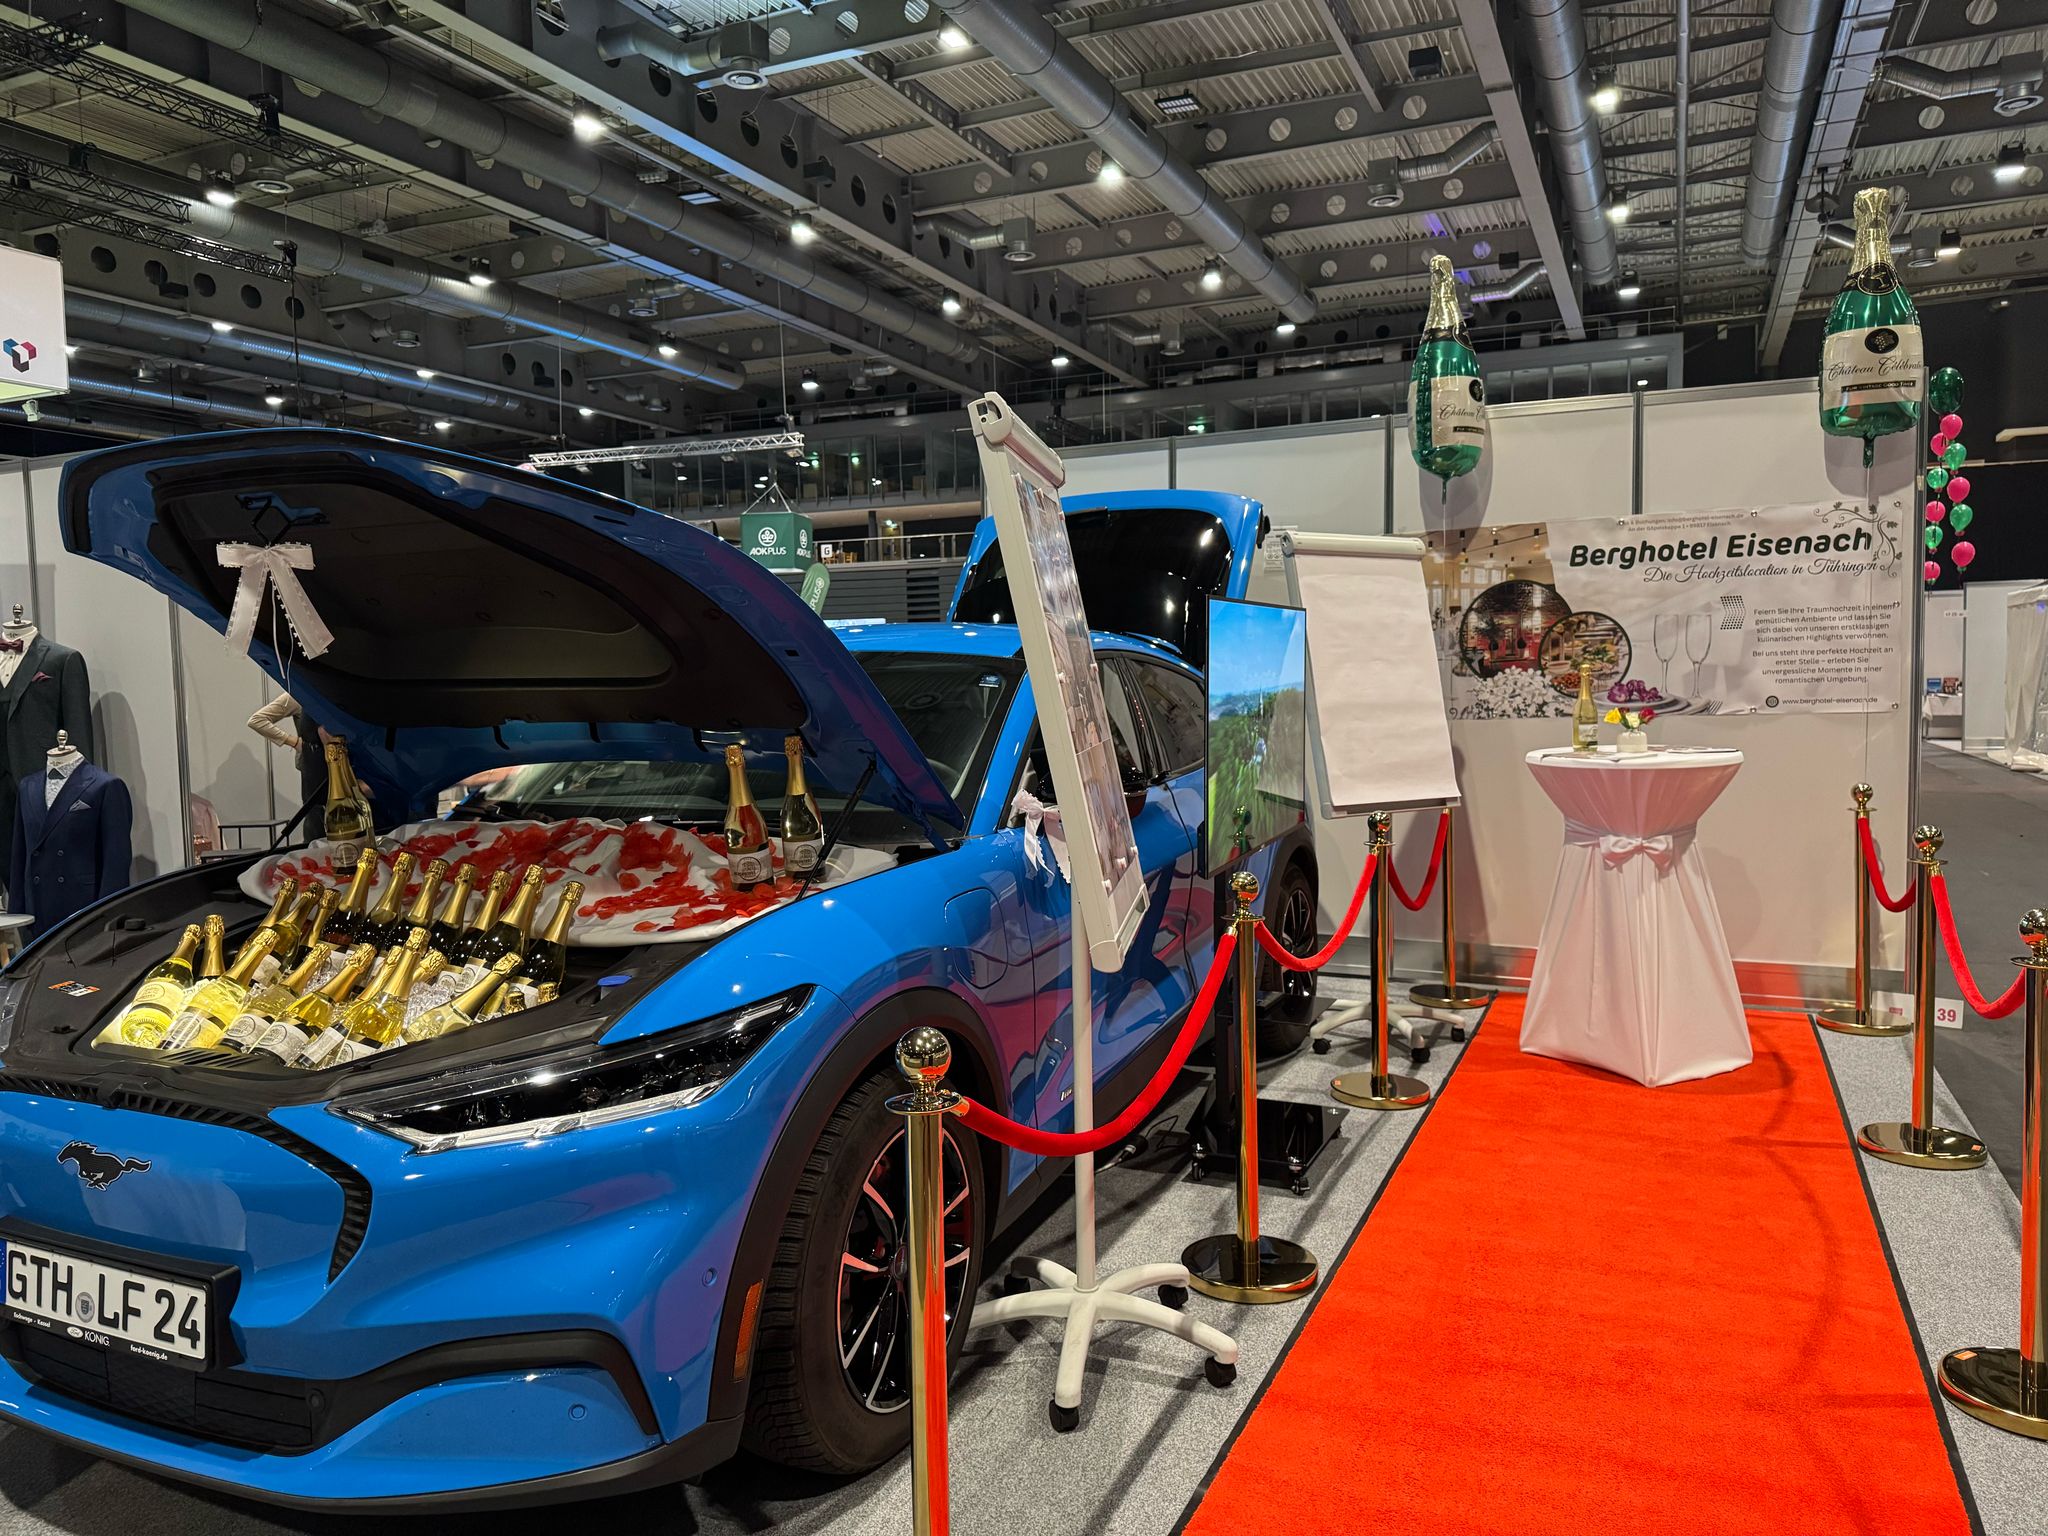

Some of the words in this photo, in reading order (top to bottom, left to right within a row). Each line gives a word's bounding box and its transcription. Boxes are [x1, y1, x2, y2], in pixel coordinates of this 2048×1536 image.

[824, 546, 830, 555] G
[1569, 536, 1718, 570] Berghotel
[1726, 527, 1872, 558] Eisenach
[1643, 565, 1673, 583] Die
[1674, 561, 1789, 585] Hochzeitslocation
[1791, 565, 1804, 575] in
[1790, 606, 1804, 614] Ihre
[1806, 604, 1861, 614] Traumhochzeit
[1754, 617, 1799, 626] gemütlichen
[1800, 615, 1836, 623] Ambiente
[1838, 614, 1853, 622] und
[1854, 613, 1877, 621] lassen
[1756, 626, 1771, 634] sich
[1772, 625, 1793, 633] dabei
[1840, 623, 1889, 632] erstklassigen
[1757, 635, 1805, 643] kulinarischen
[1806, 633, 1843, 642] Highlights
[1844, 632, 1888, 640] verwöhnen.
[1752, 649, 1765, 657] Bei
[1816, 647, 1848, 657] perfekte
[1849, 646, 1882, 654] Hochzeit
[1775, 658, 1797, 666] erster
[1798, 657, 1819, 665] Stelle
[1827, 656, 1856, 664] erleben
[1762, 667, 1816, 676] unvergessliche
[1817, 666, 1853, 674] Momente
[1775, 676, 1825, 684] romantischen
[1937, 1007, 1957, 1022] 39
[8, 1250, 73, 1316] GTH
[98, 1273, 145, 1332] LF
[153, 1288, 201, 1350] 24
